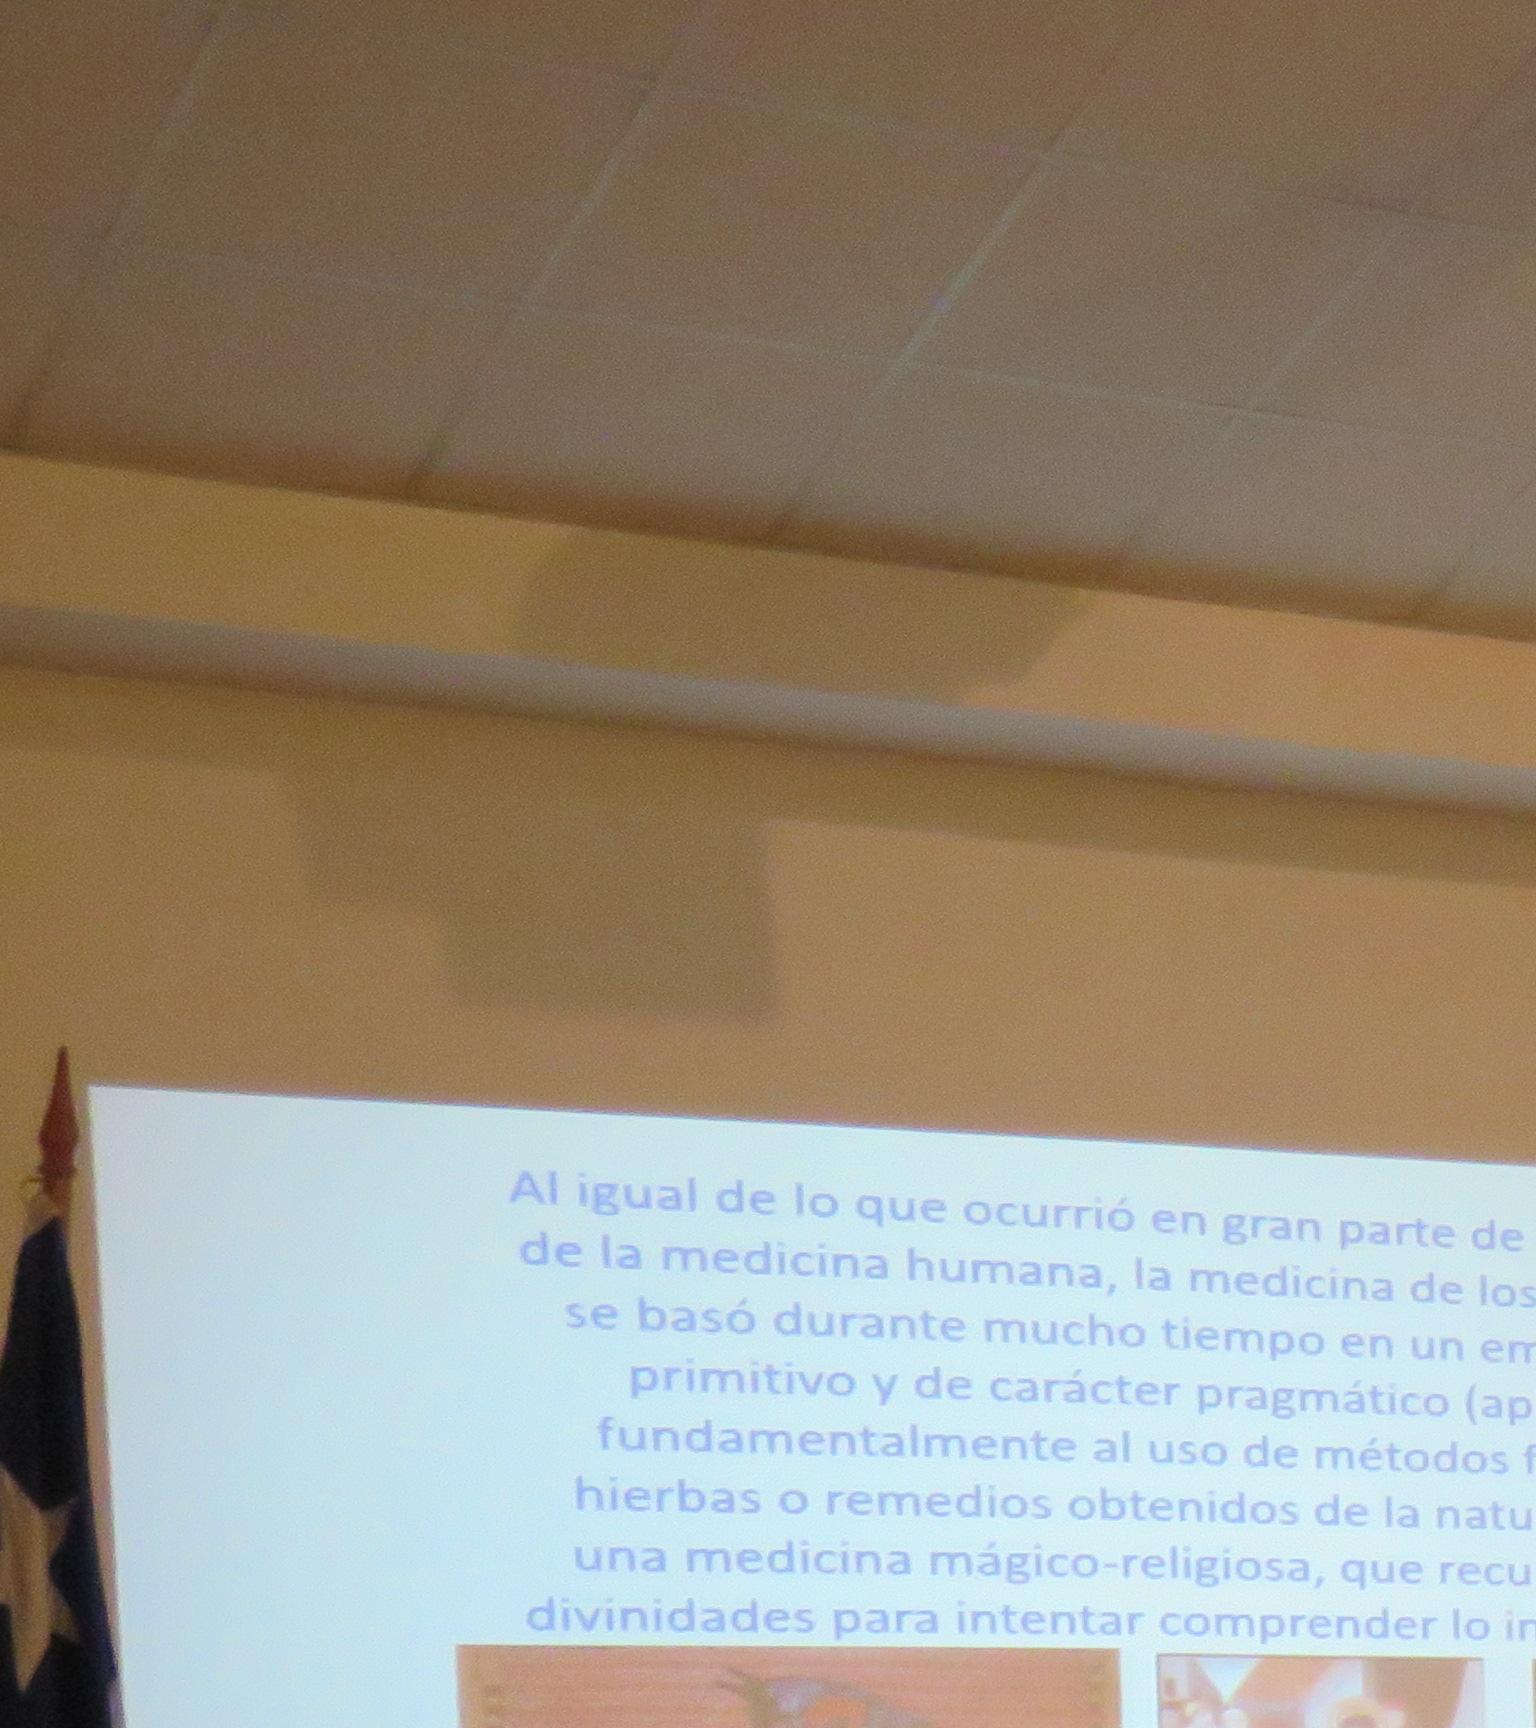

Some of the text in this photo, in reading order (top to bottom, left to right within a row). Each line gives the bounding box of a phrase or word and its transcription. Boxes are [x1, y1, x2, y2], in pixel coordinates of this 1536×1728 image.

[508, 1170, 560, 1206] Al
[577, 1174, 699, 1217] igual
[714, 1179, 778, 1216] de
[794, 1182, 841, 1219] lo
[854, 1195, 949, 1228] que
[962, 1200, 1137, 1233] ocurrió
[1150, 1209, 1208, 1236] en
[1221, 1213, 1323, 1246] gran
[1338, 1218, 1457, 1251] parte
[1470, 1219, 1525, 1253] de
[518, 1231, 584, 1268] de
[600, 1234, 644, 1270] la
[661, 1241, 891, 1280] medicina
[906, 1247, 1118, 1296] humana,
[1134, 1257, 1173, 1292] la
[1188, 1265, 1395, 1302] medicina
[1409, 1272, 1465, 1305] de
[564, 1303, 620, 1331] se
[636, 1296, 758, 1335] basó
[772, 1302, 968, 1343] durante
[982, 1313, 1148, 1348] mucho
[1160, 1319, 1327, 1362] tiempo
[1339, 1333, 1395, 1359] en
[1410, 1336, 1465, 1362] un
[629, 1362, 858, 1399] primitivo
[871, 1374, 900, 1406] y
[913, 1366, 974, 1401] de
[988, 1369, 1182, 1407] carácter
[1196, 1380, 1451, 1420] pragmático
[596, 1415, 1079, 1463] fundamentalmente
[1092, 1430, 1132, 1464] al
[1147, 1440, 1230, 1467] uso
[1242, 1435, 1300, 1470] de
[1314, 1437, 1510, 1476] métodos
[574, 1475, 763, 1514] hierbas
[777, 1489, 810, 1515] o
[825, 1484, 1054, 1520] remedios
[1066, 1487, 1301, 1526] obtenidos
[1313, 1494, 1370, 1528] de
[1384, 1495, 1421, 1529] la
[573, 1546, 669, 1573] una
[685, 1539, 913, 1576] medicina
[928, 1542, 1326, 1589] mágico-religiosa,
[1339, 1559, 1425, 1591] que
[525, 1596, 816, 1633] divinidades
[832, 1608, 940, 1640] para
[955, 1601, 1146, 1637] intentar
[1158, 1607, 1439, 1645] comprender
[1451, 1608, 1492, 1642] lo
